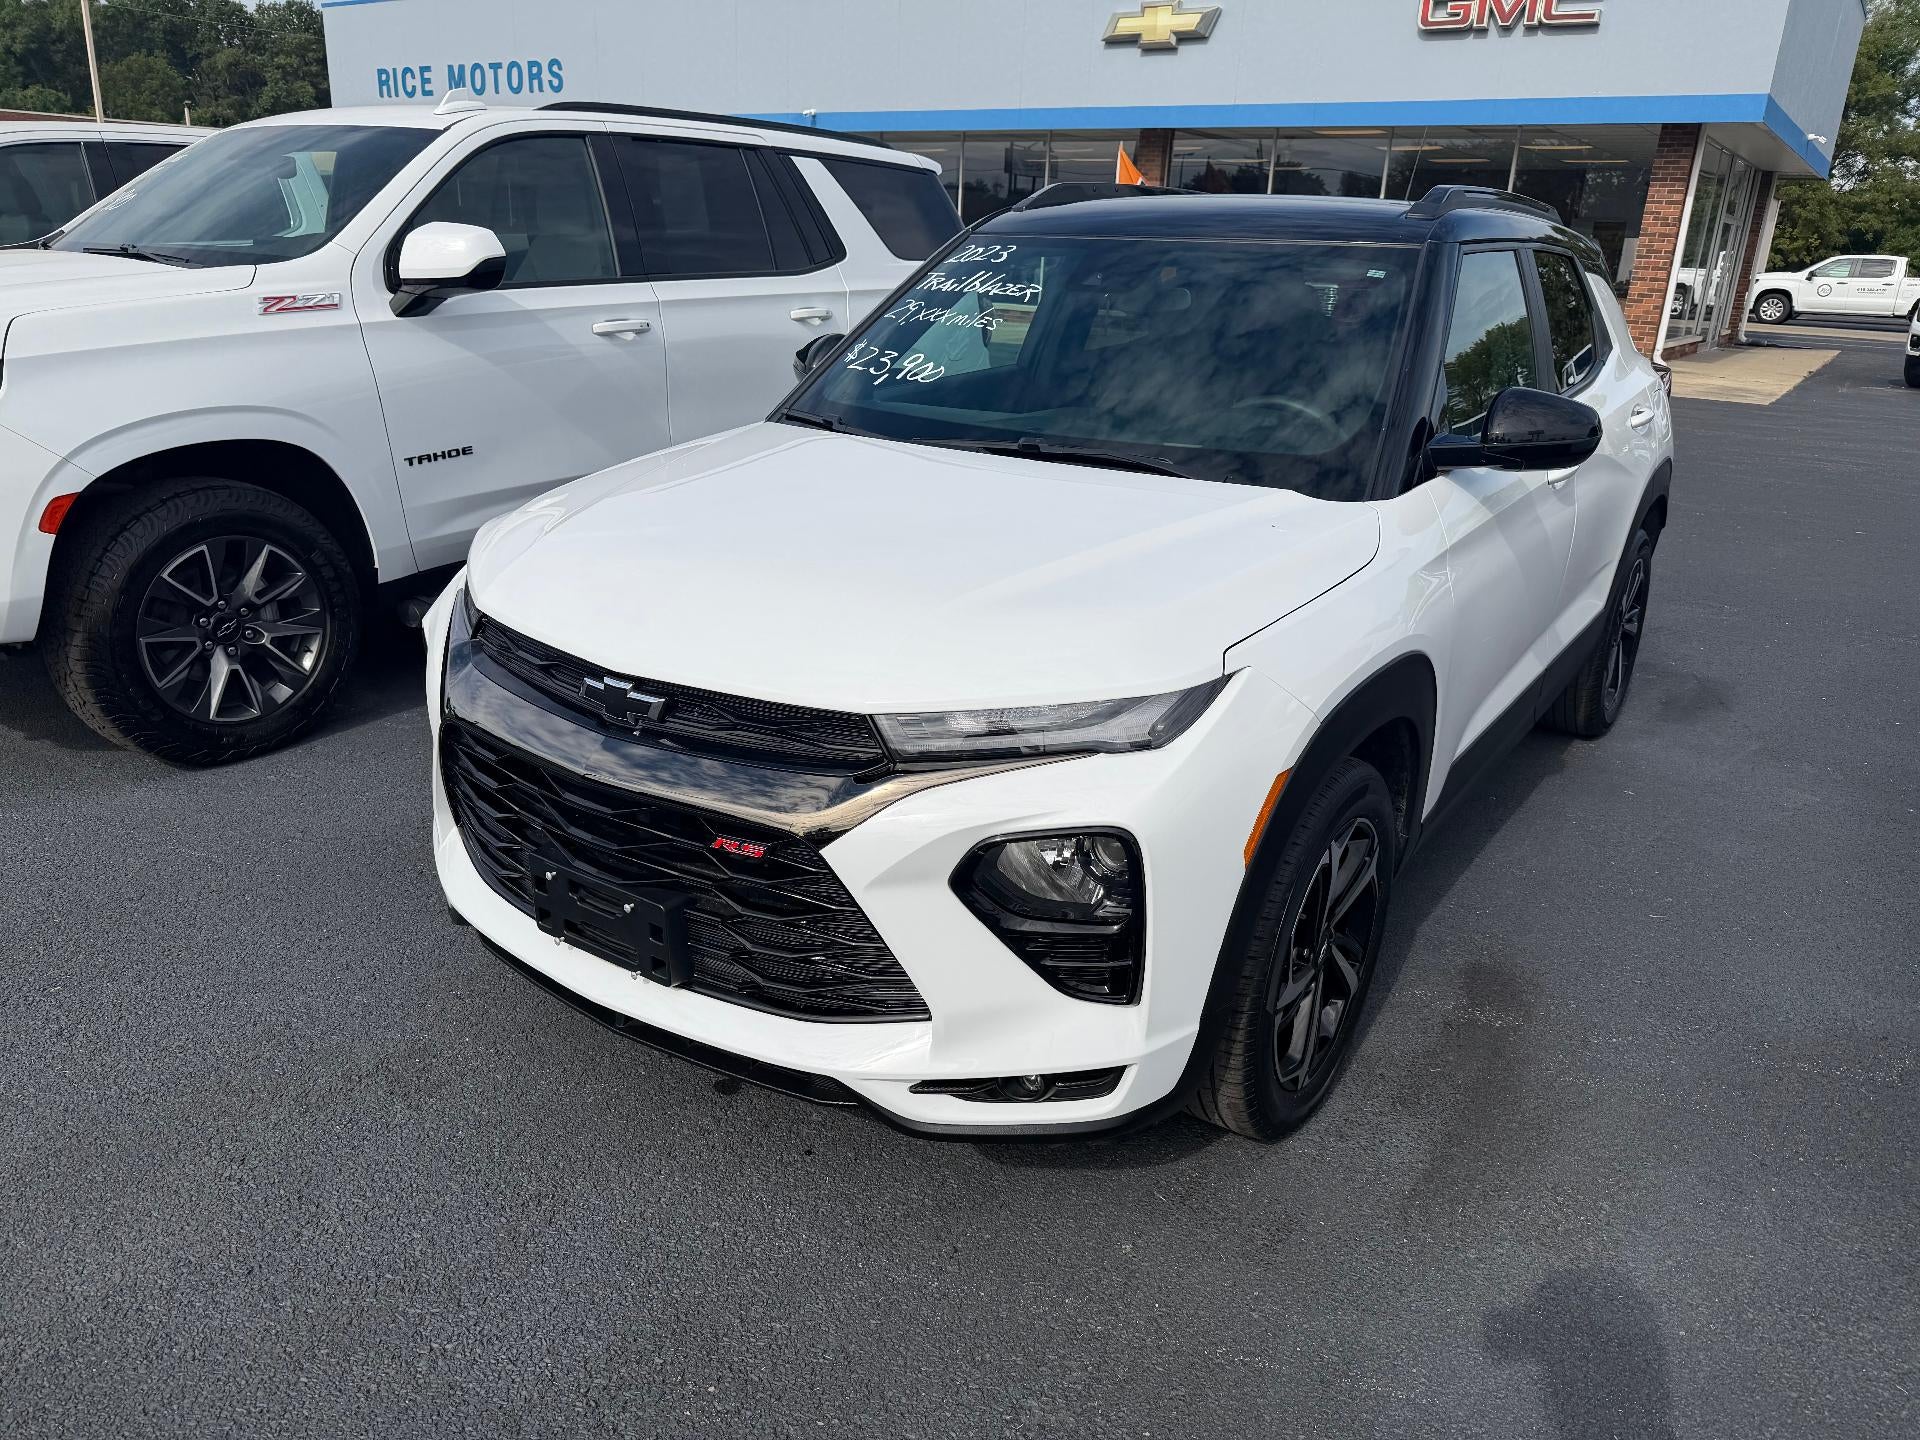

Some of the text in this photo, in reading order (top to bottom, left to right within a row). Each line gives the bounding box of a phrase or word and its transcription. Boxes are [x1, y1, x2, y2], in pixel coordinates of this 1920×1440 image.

[376, 57, 564, 98] RICE MOTORS
[944, 245, 1017, 263] 2023
[258, 292, 342, 315] Z71
[844, 338, 945, 386] $23,900
[404, 446, 474, 467] TAHOE
[710, 837, 767, 858] RS
